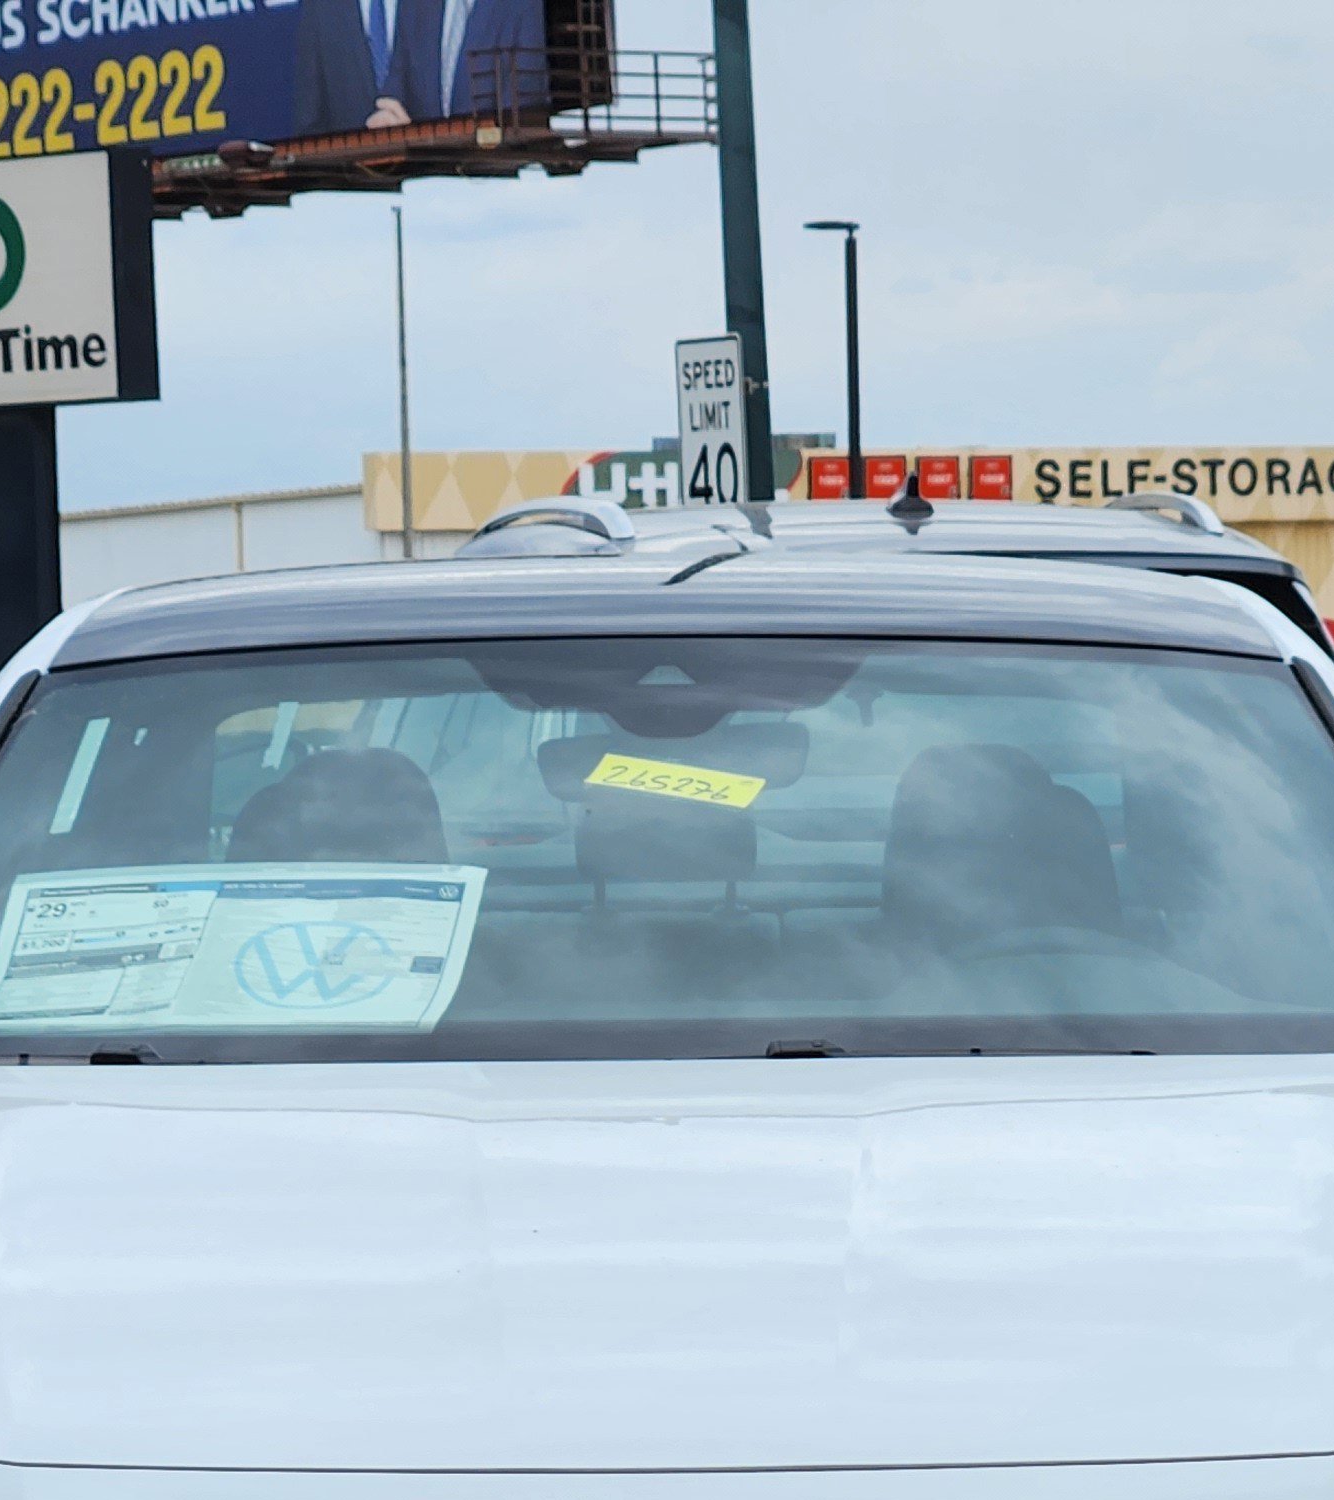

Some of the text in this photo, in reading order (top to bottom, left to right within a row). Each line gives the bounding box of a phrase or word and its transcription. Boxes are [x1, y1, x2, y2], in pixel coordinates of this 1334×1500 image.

[37, 0, 254, 45] SCHAN
[683, 359, 735, 391] SPEED
[689, 401, 731, 432] LIMIT
[689, 442, 738, 505] 40
[36, 902, 67, 919] 29
